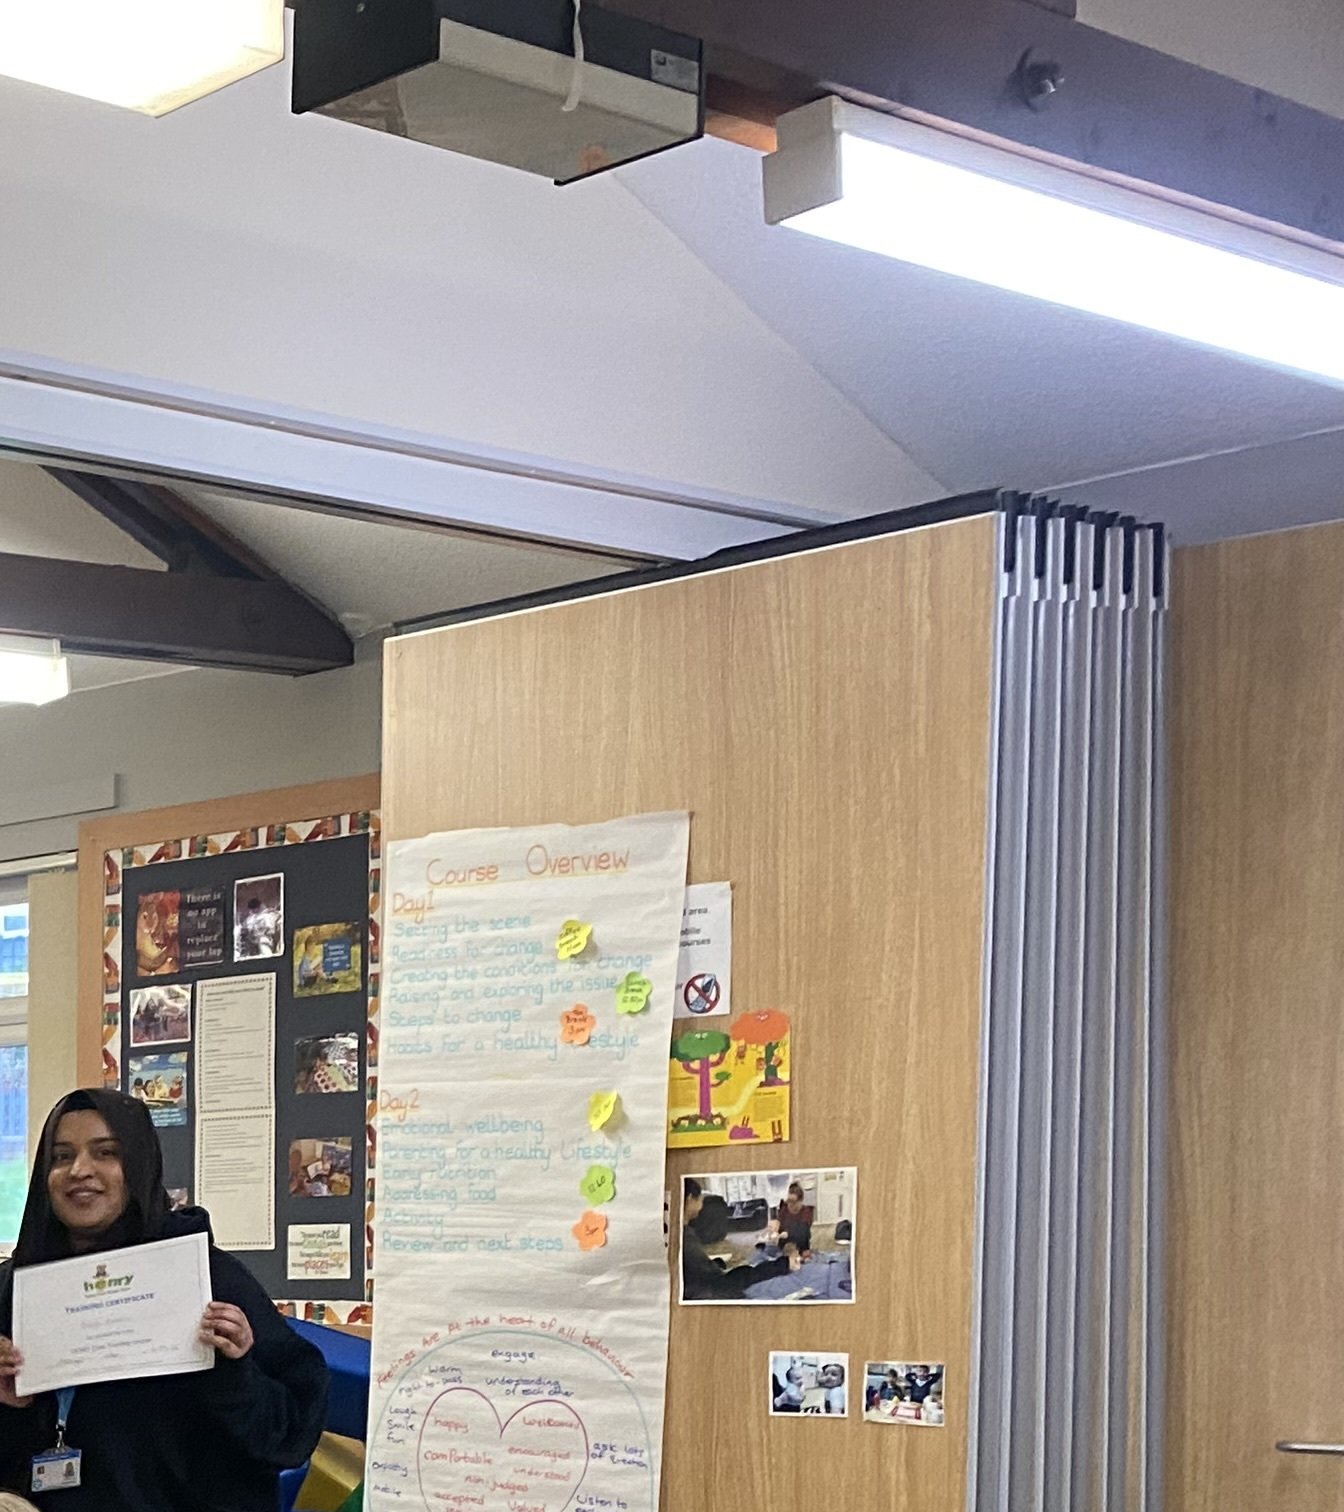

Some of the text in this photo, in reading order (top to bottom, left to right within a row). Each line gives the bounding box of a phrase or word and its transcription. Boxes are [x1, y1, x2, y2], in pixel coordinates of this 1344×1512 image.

[426, 844, 630, 885] Course Overview
[394, 916, 531, 943] Setting the scene
[187, 934, 218, 945] replace
[187, 947, 222, 959] your lap
[392, 967, 449, 991] Creating
[456, 965, 479, 979] the
[484, 958, 556, 978] conditions
[596, 952, 652, 974] change
[390, 990, 440, 1013] Raising
[484, 979, 543, 1005] exploring
[550, 978, 573, 993] the
[390, 1007, 521, 1032] Steps to change
[443, 1038, 465, 1051] for
[474, 1041, 484, 1050] a
[494, 1031, 558, 1061] healthy
[381, 1114, 544, 1144] Emotional wellbeing
[382, 1143, 446, 1169] Parenting
[455, 1141, 477, 1158] for
[495, 1142, 552, 1171] healthy
[383, 1166, 421, 1189] Early
[468, 1184, 496, 1200] food
[383, 1232, 563, 1252] Review and next steps
[84, 1274, 134, 1292] henry
[377, 1350, 416, 1389] Feelings
[466, 1316, 490, 1326] the
[499, 1314, 532, 1325] heart
[540, 1318, 557, 1331] of
[558, 1326, 575, 1339] all
[582, 1332, 634, 1379] behaviour
[492, 1349, 535, 1363] engage
[485, 1377, 561, 1389] understanding
[505, 1387, 574, 1397] of each other
[434, 1417, 469, 1433] happy
[508, 1446, 570, 1462] encouraged
[594, 1443, 617, 1452] ask
[424, 1450, 493, 1465] comfortable
[514, 1467, 570, 1481] understood
[616, 1500, 628, 1509] to
